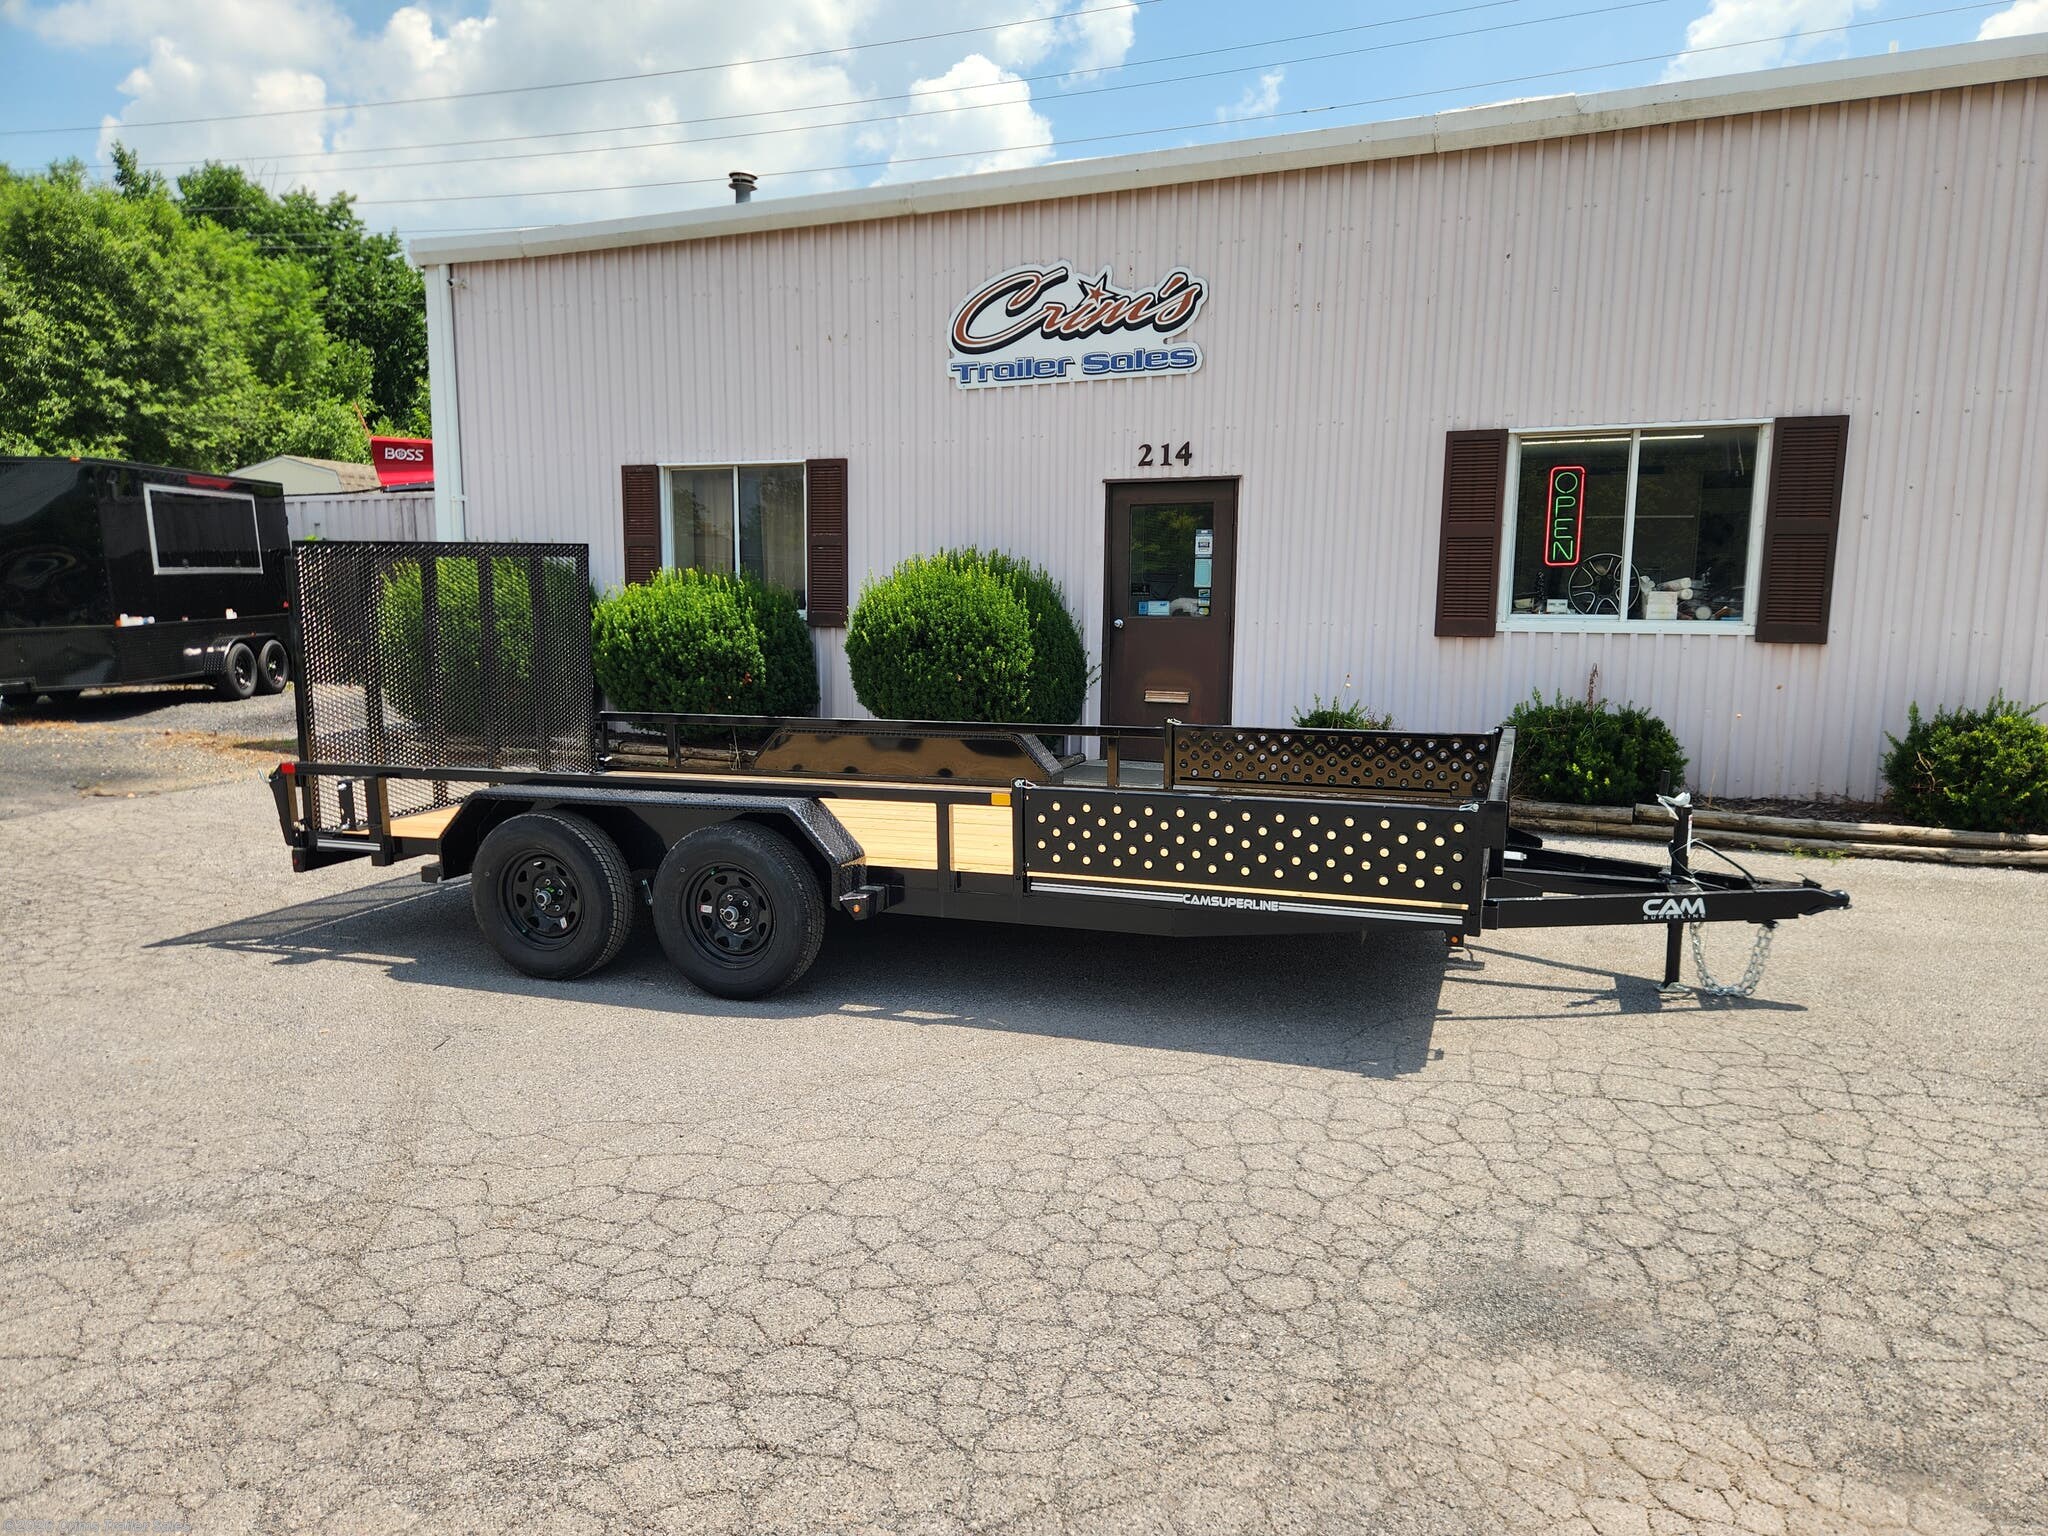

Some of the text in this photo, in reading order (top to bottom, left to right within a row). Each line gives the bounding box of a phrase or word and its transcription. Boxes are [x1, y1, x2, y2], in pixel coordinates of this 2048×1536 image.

[952, 266, 1202, 354] Crim's
[951, 347, 1197, 384] Trailer Sales
[384, 447, 424, 461] BOSS
[1137, 441, 1192, 467] 214
[1552, 471, 1579, 562] OPEN
[1642, 897, 1706, 916] CAM
